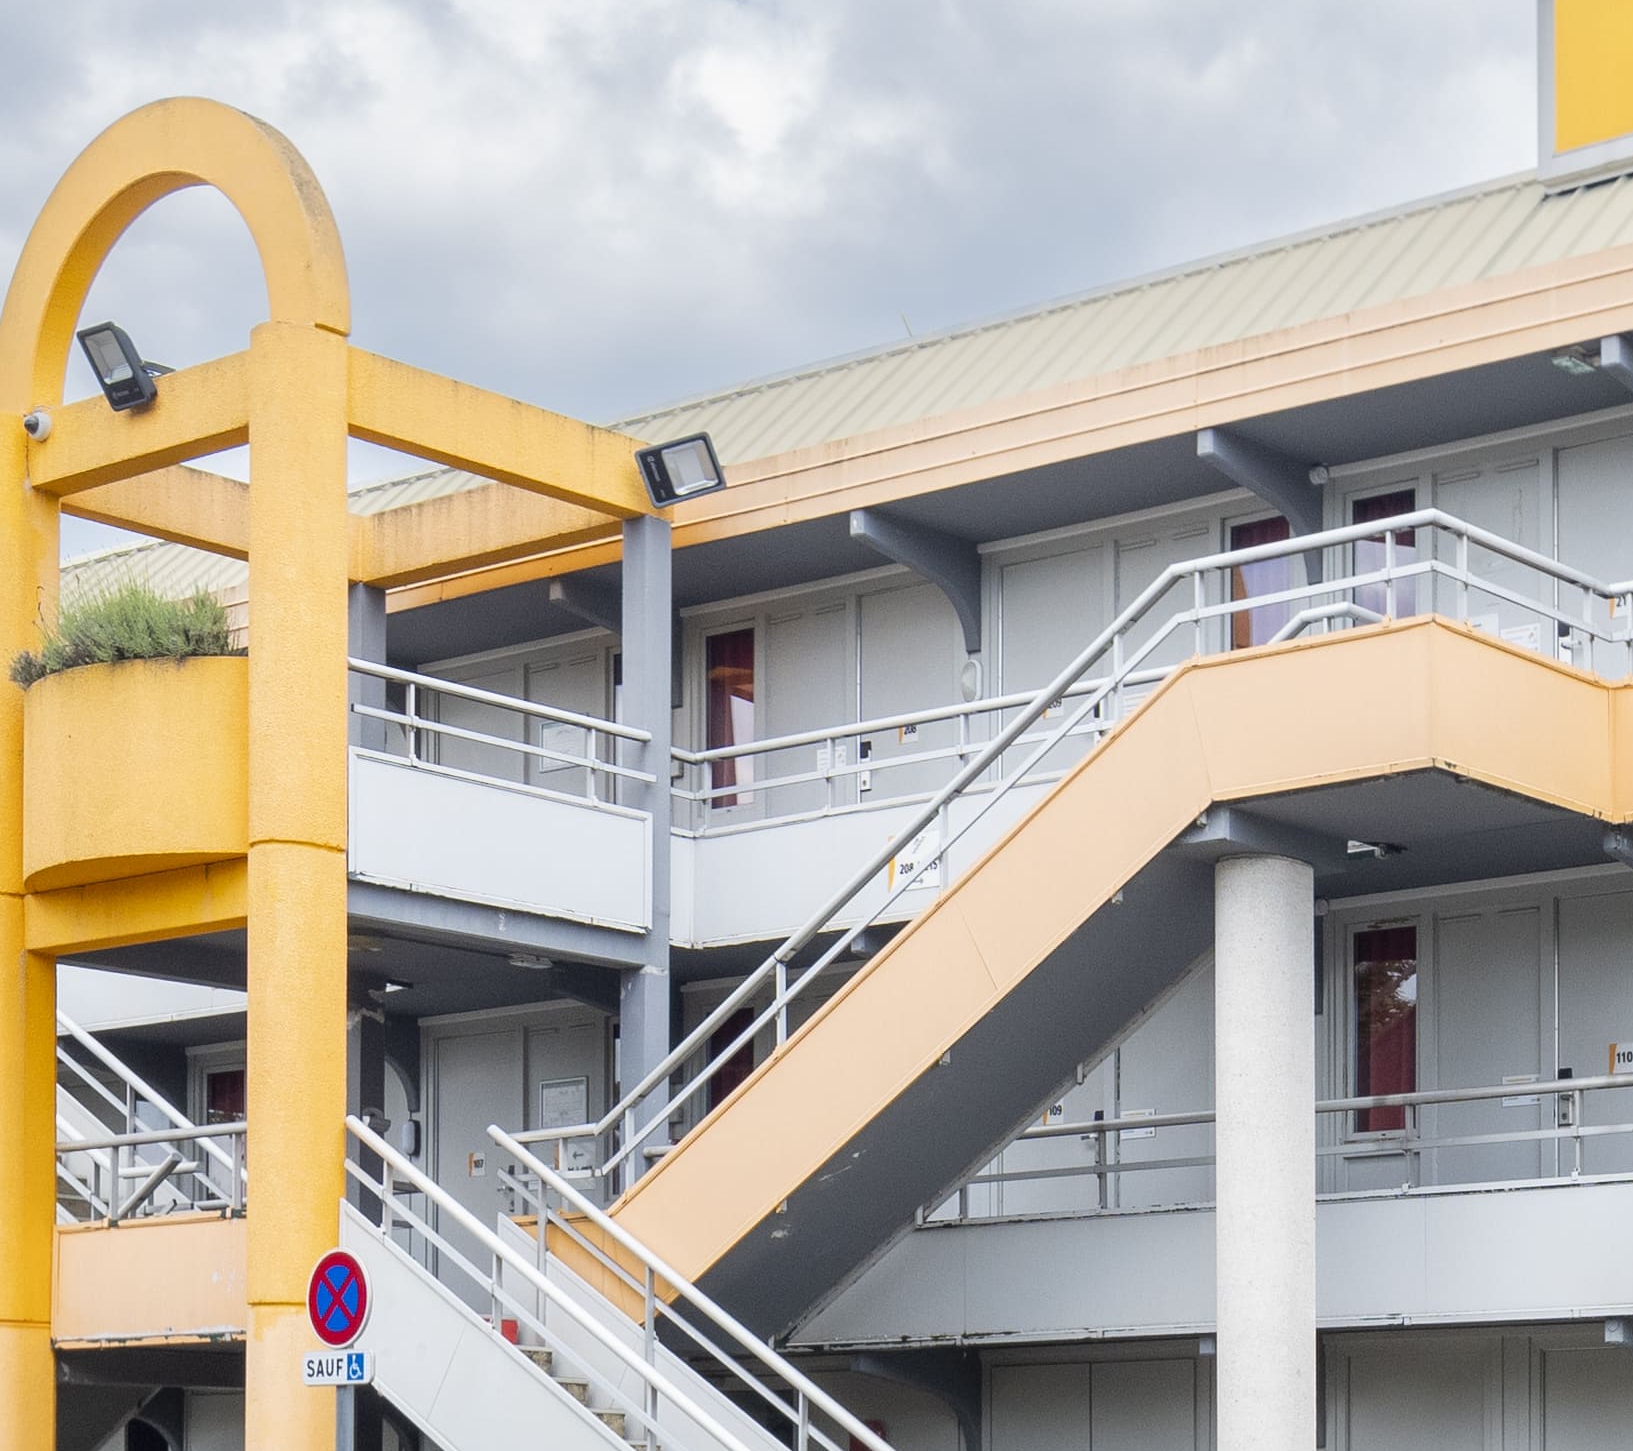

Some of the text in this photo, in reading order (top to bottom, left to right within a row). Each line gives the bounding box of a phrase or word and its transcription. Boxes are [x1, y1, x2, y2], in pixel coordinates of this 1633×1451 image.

[1616, 1051, 1633, 1064] 110
[1049, 1104, 1062, 1116] 109
[473, 1158, 484, 1169] 107
[307, 1358, 344, 1378] SAUF
